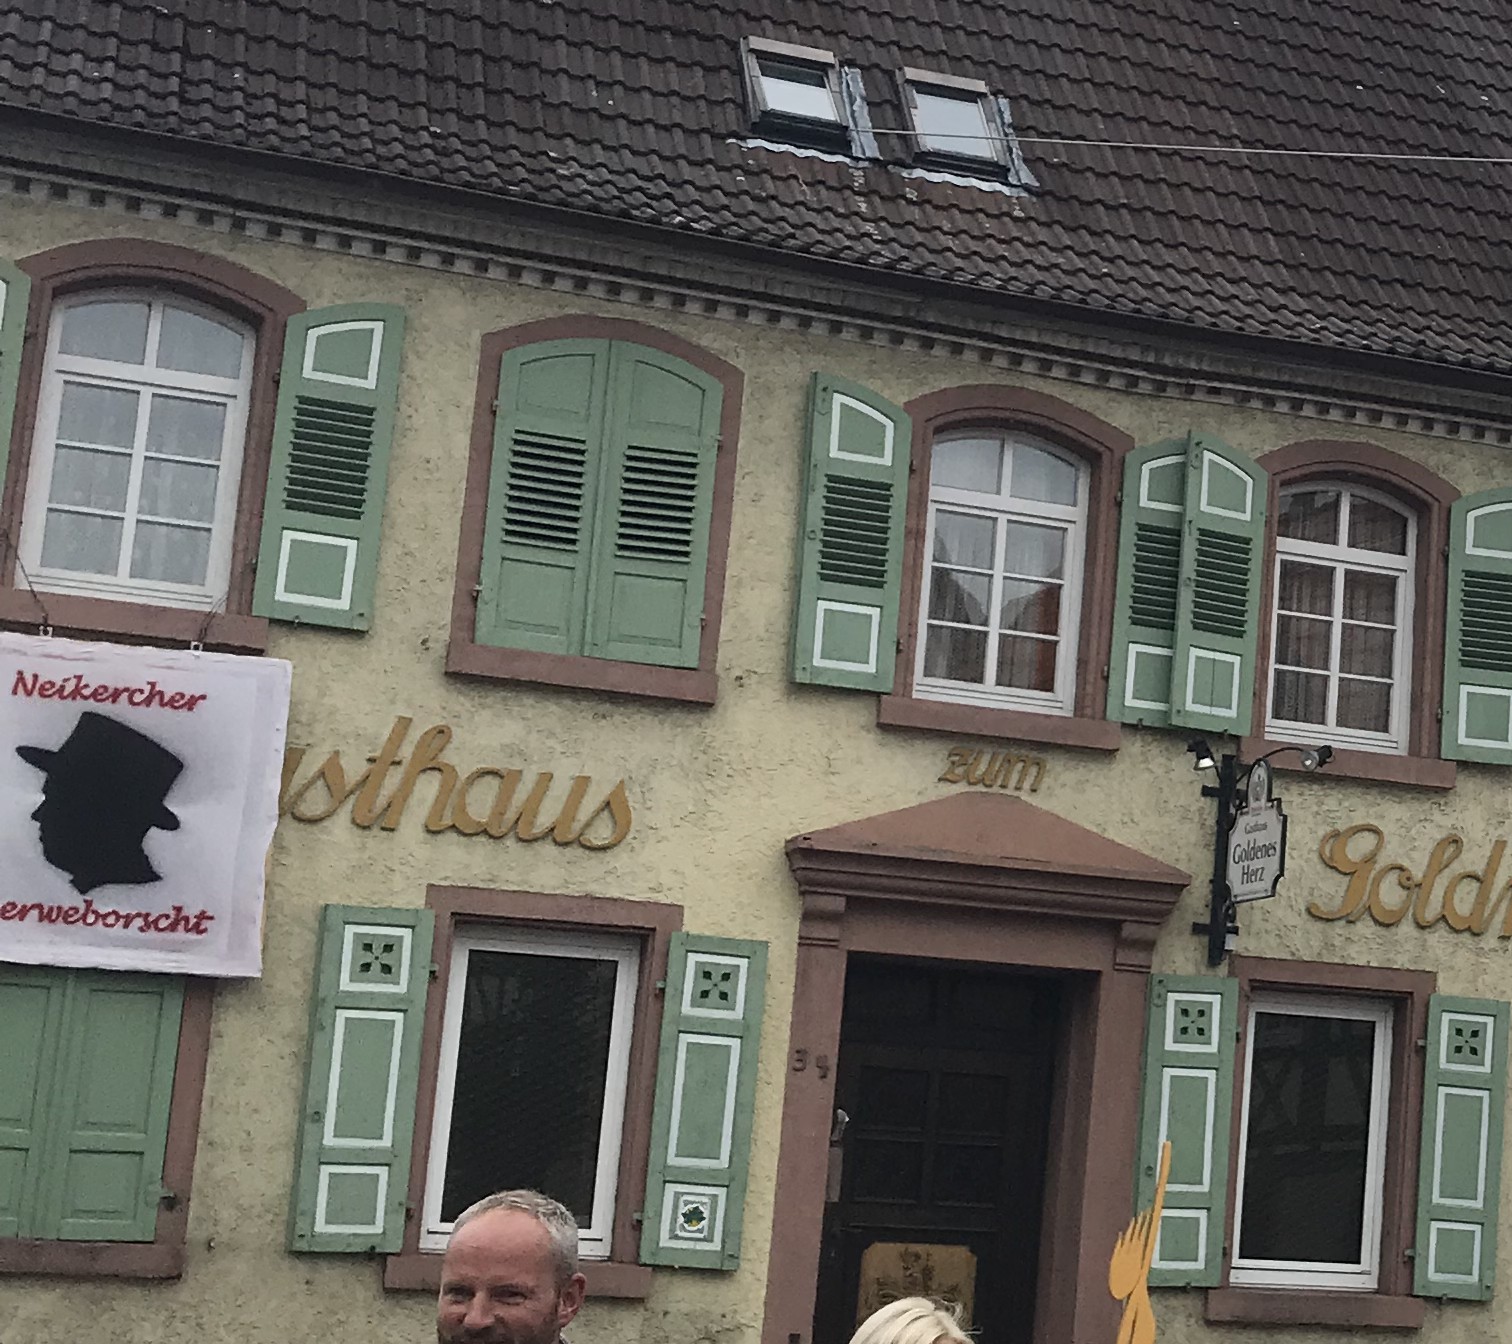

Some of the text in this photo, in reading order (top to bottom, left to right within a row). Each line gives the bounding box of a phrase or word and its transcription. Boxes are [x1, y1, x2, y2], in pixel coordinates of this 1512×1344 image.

[11, 670, 208, 712] Neikercher
[937, 746, 1047, 793] zum
[1232, 839, 1277, 865] Goldenes
[1241, 865, 1265, 885] Herz
[0, 899, 215, 935] erweborscht
